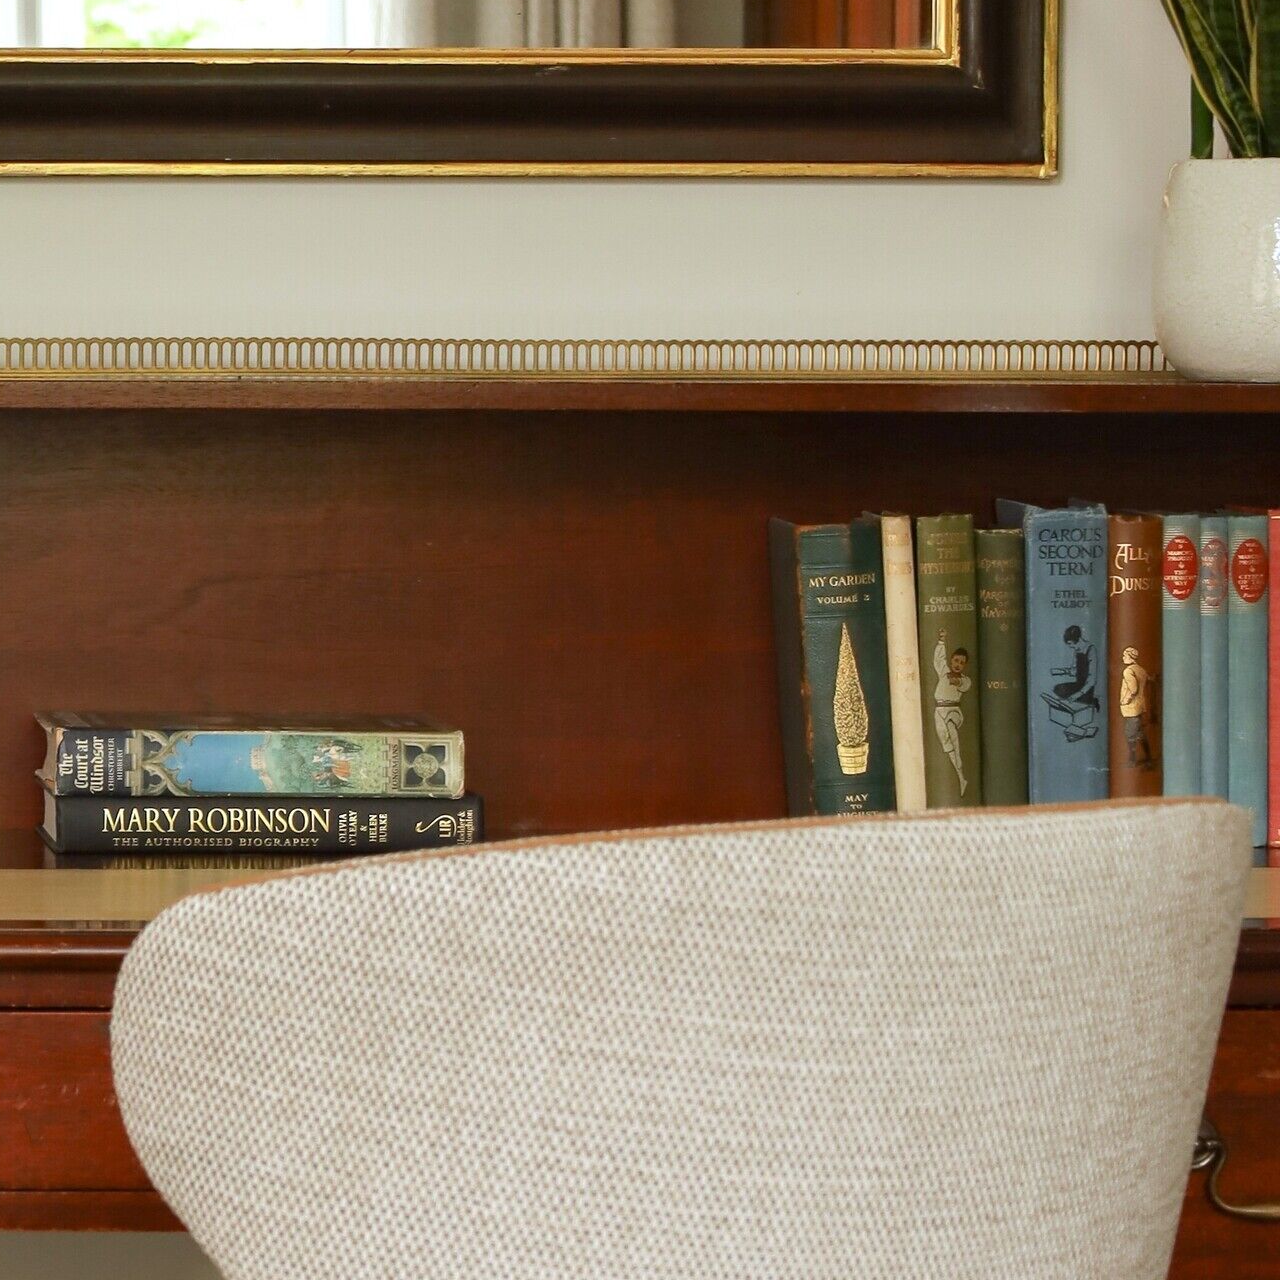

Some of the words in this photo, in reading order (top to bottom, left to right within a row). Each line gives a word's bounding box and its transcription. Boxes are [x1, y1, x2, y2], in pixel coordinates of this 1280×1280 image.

[1038, 527, 1102, 543] CAROL'S
[1038, 544, 1104, 560] SECOND
[1046, 561, 1094, 577] TERM
[808, 576, 827, 588] MY
[829, 572, 876, 587] GARDEN
[816, 594, 858, 604] VOLUME
[863, 593, 870, 601] 2
[1055, 590, 1088, 599] ETHEL
[1051, 600, 1092, 610] TALBOT
[75, 738, 89, 752] at
[59, 752, 74, 777] The
[74, 753, 89, 789] Court
[89, 735, 105, 795] Windsor
[107, 736, 115, 791] CHRISTOPHER
[391, 743, 399, 790] LONGMANS
[844, 792, 869, 803] MAY
[101, 807, 181, 834] MARY
[187, 807, 332, 834] ROBINSON
[338, 813, 348, 843] OLIVIA
[368, 814, 378, 843] HELEN
[378, 813, 388, 843] BURKE
[438, 819, 452, 838] LIR
[112, 836, 140, 847] THE
[144, 836, 234, 847] AUTHORISED
[238, 836, 321, 847] BIOGRAPHY
